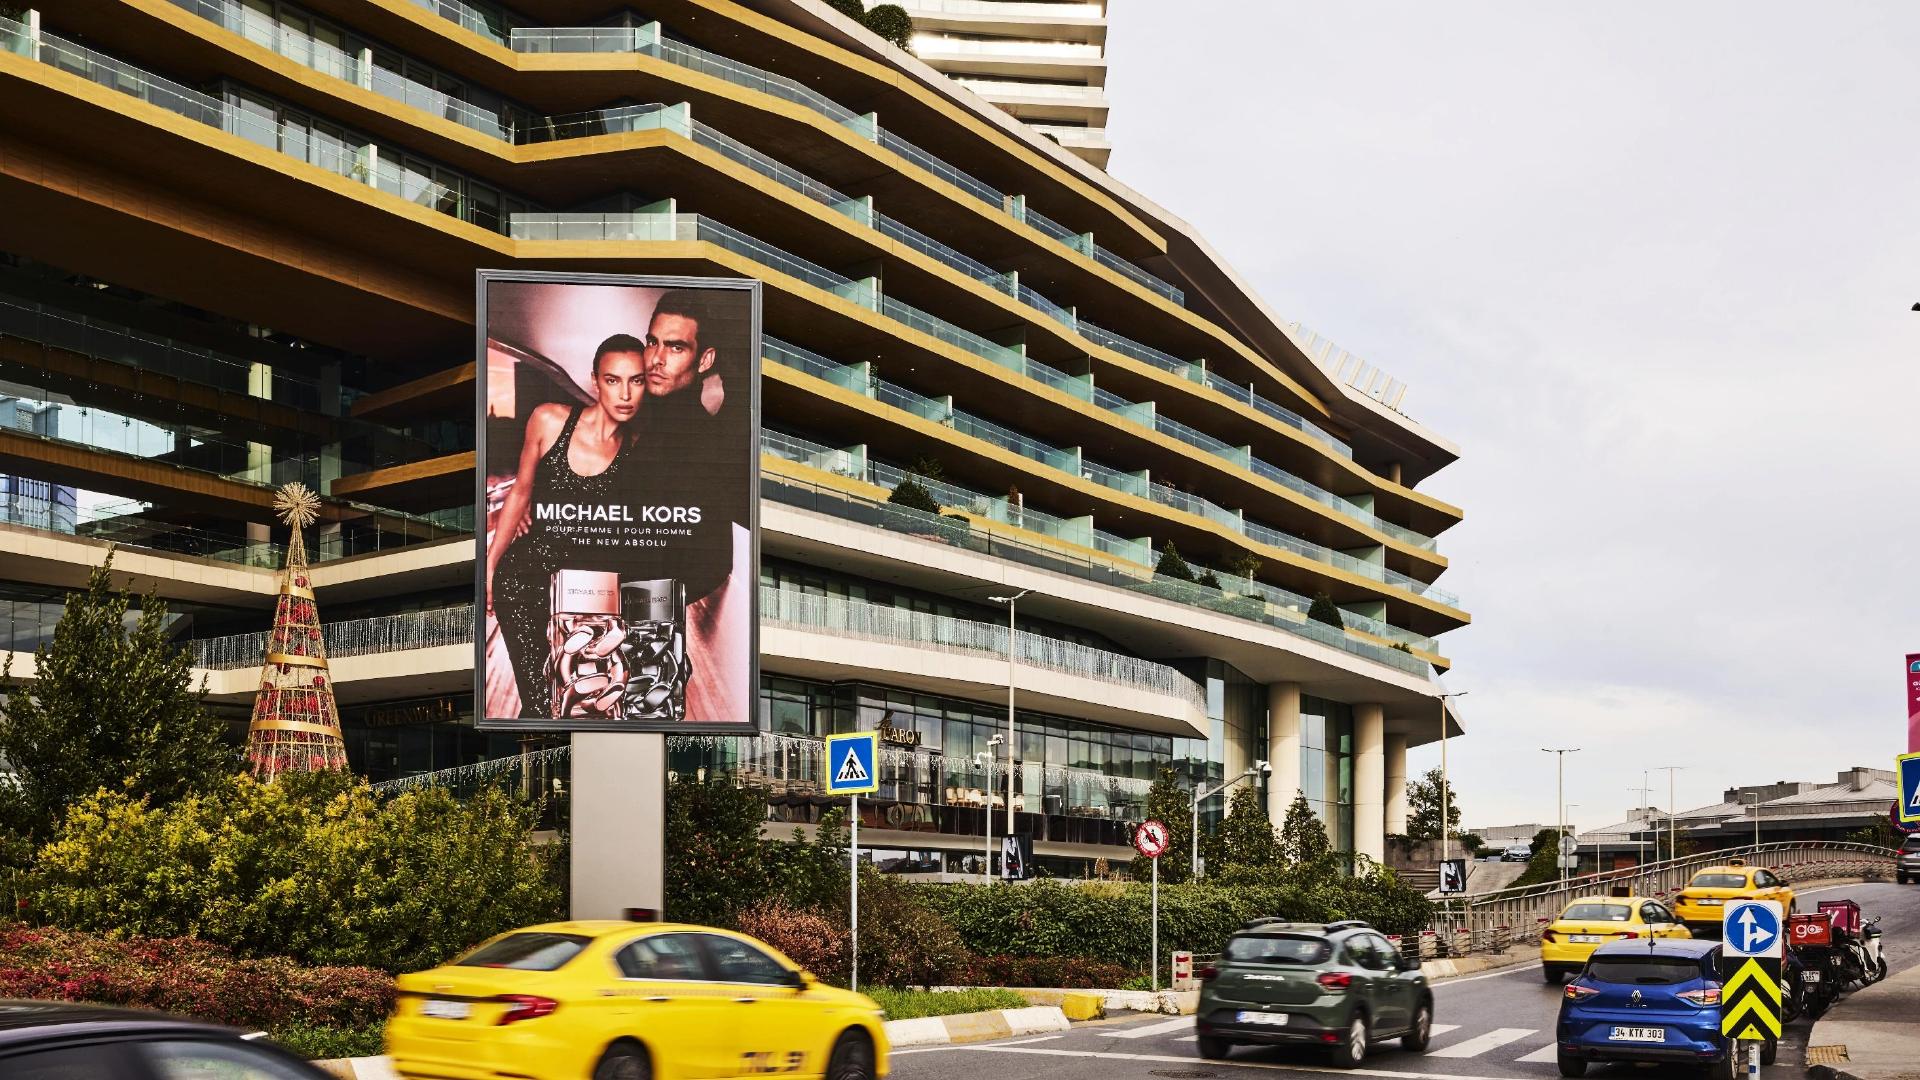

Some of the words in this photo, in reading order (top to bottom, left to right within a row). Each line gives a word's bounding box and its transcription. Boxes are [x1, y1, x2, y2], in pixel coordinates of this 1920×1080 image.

[536, 503, 634, 522] MICHAEL
[642, 505, 702, 524] KORS
[545, 525, 573, 533] POUR
[577, 526, 613, 534] FEMME
[624, 527, 652, 535] POUR
[656, 528, 693, 536] HOMME
[571, 537, 592, 545] THE
[596, 538, 620, 546] NEW
[624, 539, 668, 547] ABSOLU
[1615, 1027, 1625, 1037] 34
[1629, 1028, 1645, 1038] KTK
[1647, 1029, 1663, 1039] 303
